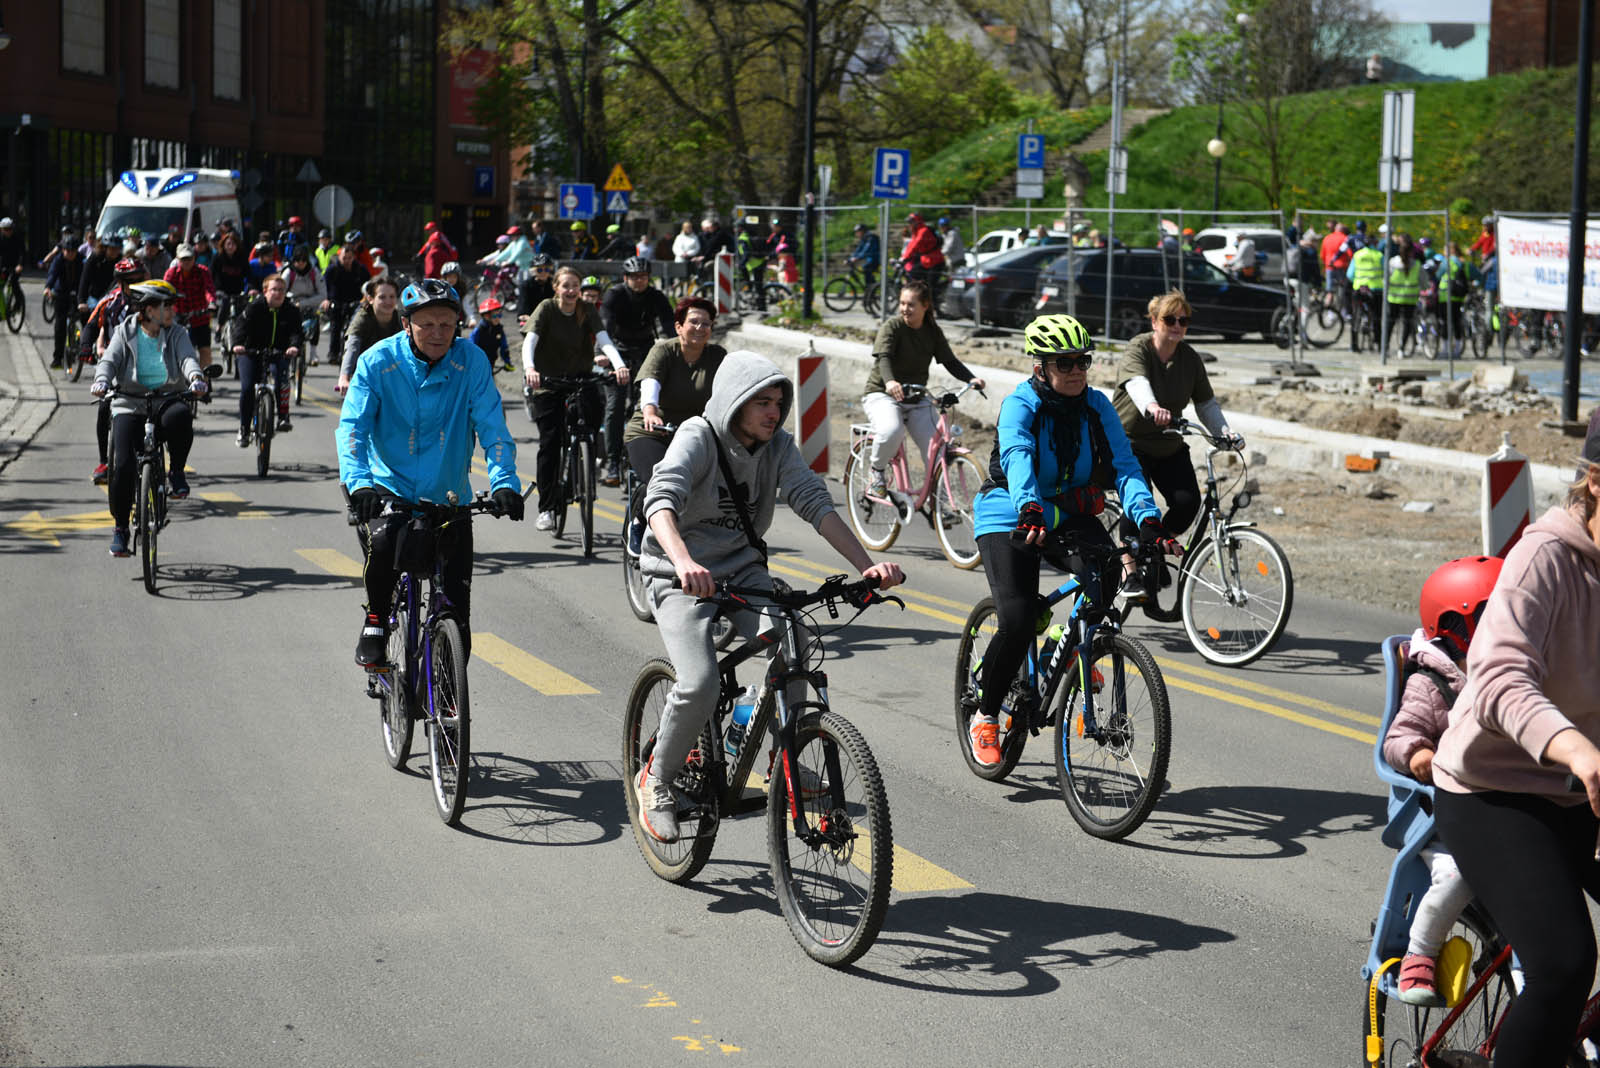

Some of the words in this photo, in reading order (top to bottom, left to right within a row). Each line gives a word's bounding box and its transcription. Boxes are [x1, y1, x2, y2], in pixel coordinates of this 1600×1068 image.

[1024, 137, 1039, 159] P
[882, 152, 903, 184] P
[480, 173, 489, 188] P
